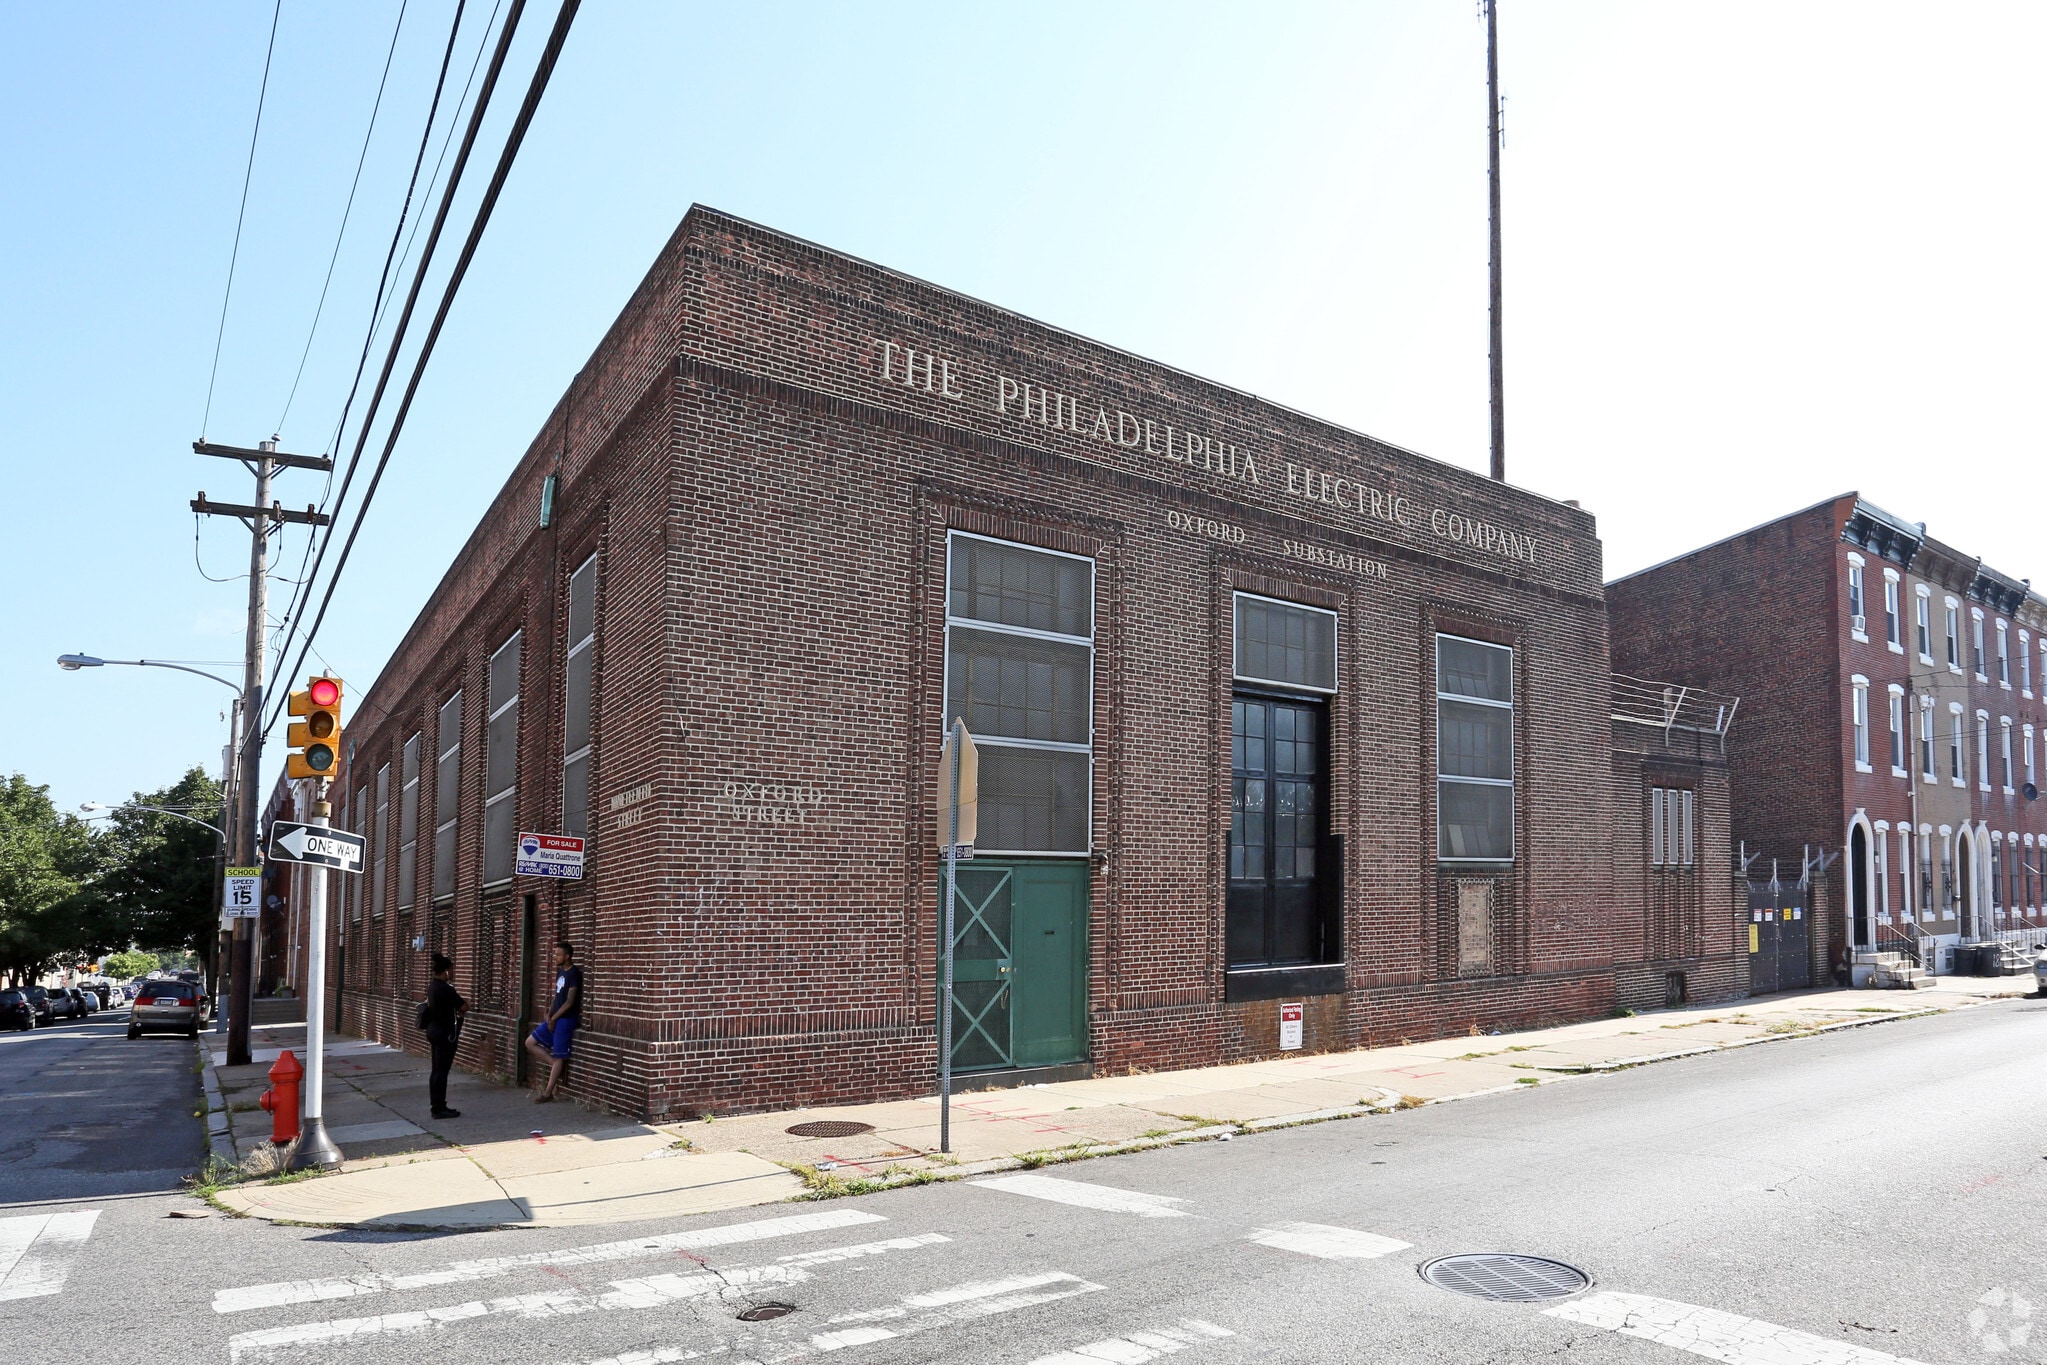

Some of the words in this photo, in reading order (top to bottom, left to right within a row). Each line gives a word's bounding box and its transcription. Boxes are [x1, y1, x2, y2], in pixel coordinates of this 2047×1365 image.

[875, 338, 962, 399] THE
[996, 375, 1260, 484] PHILADELPHIA
[1286, 463, 1411, 526] ELECTRIC
[1431, 508, 1538, 563] COMPANY
[1168, 510, 1245, 543] OXFORD
[1283, 539, 1388, 579] SUBSTATION
[724, 782, 821, 803] OXFORD
[732, 805, 808, 822] STREET
[307, 837, 333, 855] ONE
[337, 842, 357, 859] WAY
[540, 851, 554, 860] Maria
[549, 864, 580, 877] 651-0800
[233, 890, 252, 905] 15
